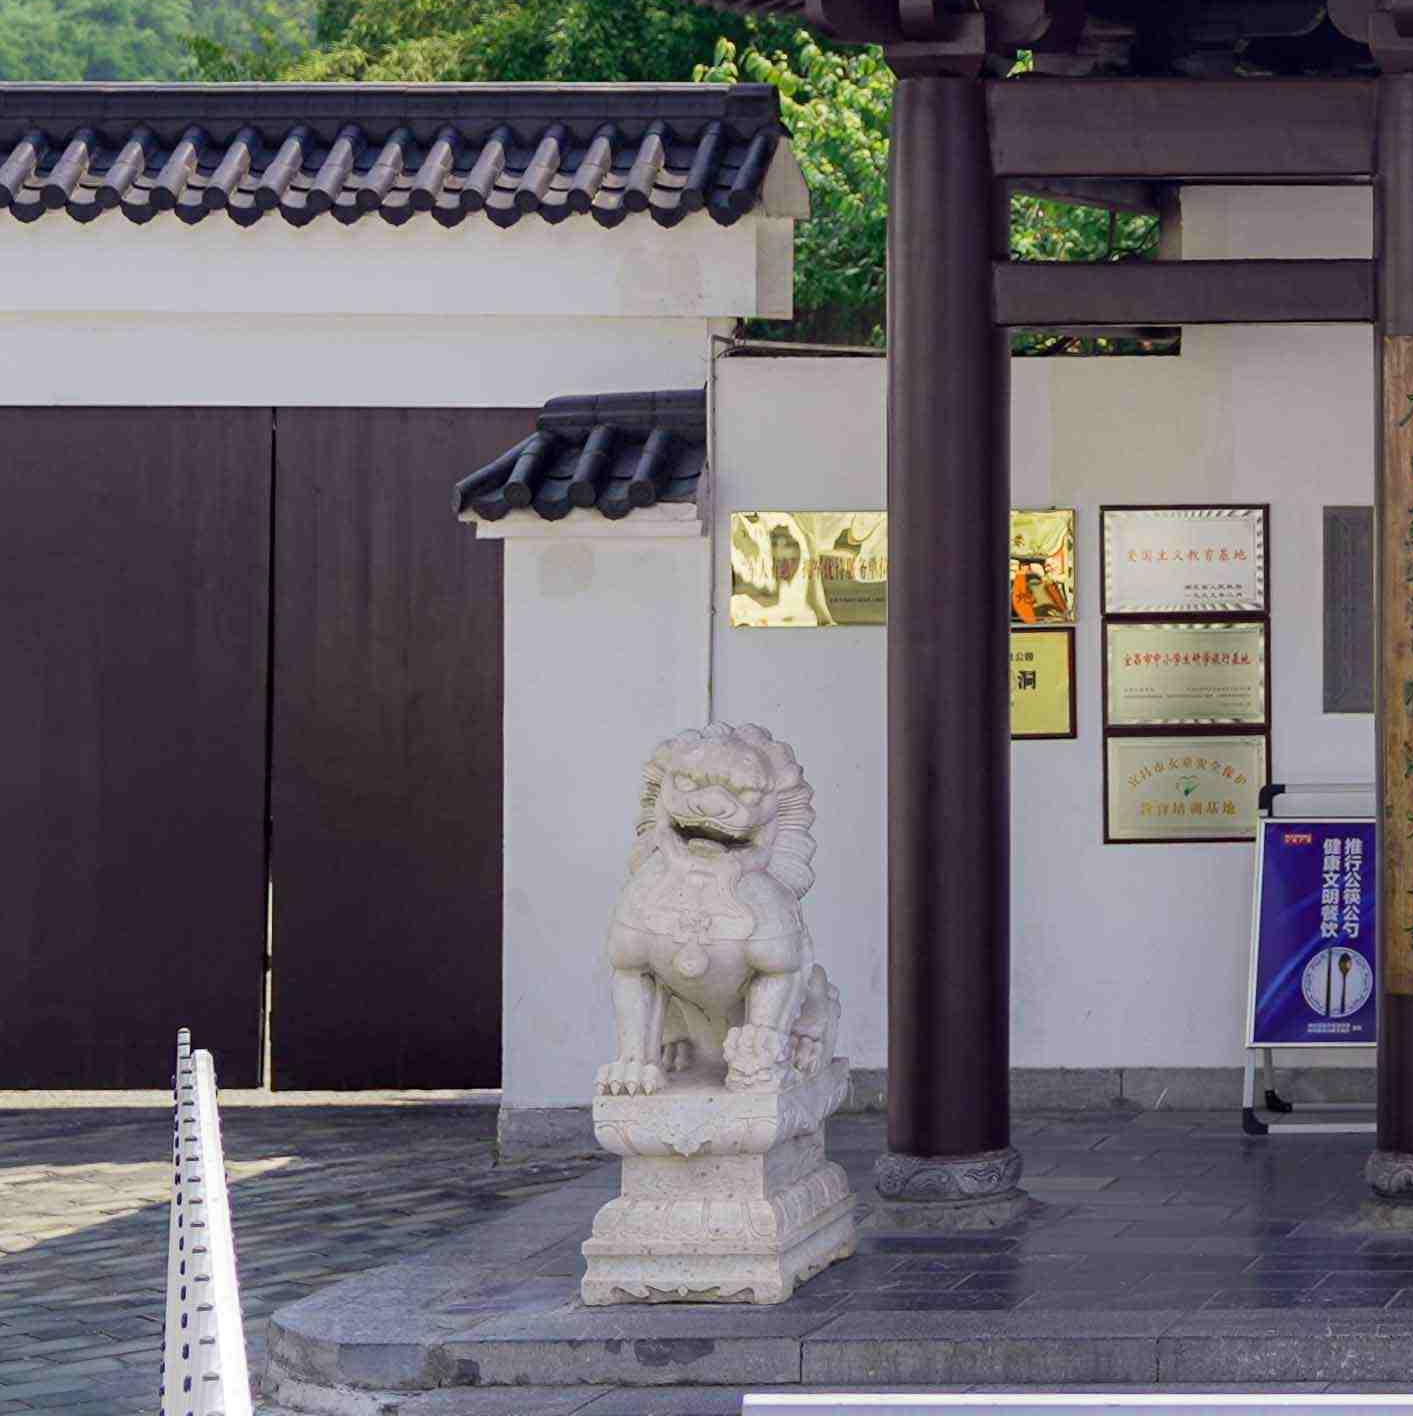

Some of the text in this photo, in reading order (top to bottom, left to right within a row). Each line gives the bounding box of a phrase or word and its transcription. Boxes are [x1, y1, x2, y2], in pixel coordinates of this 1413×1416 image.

[1320, 837, 1342, 939] 健康文明餐饮
[1342, 837, 1364, 939] 推行公筷公勺
